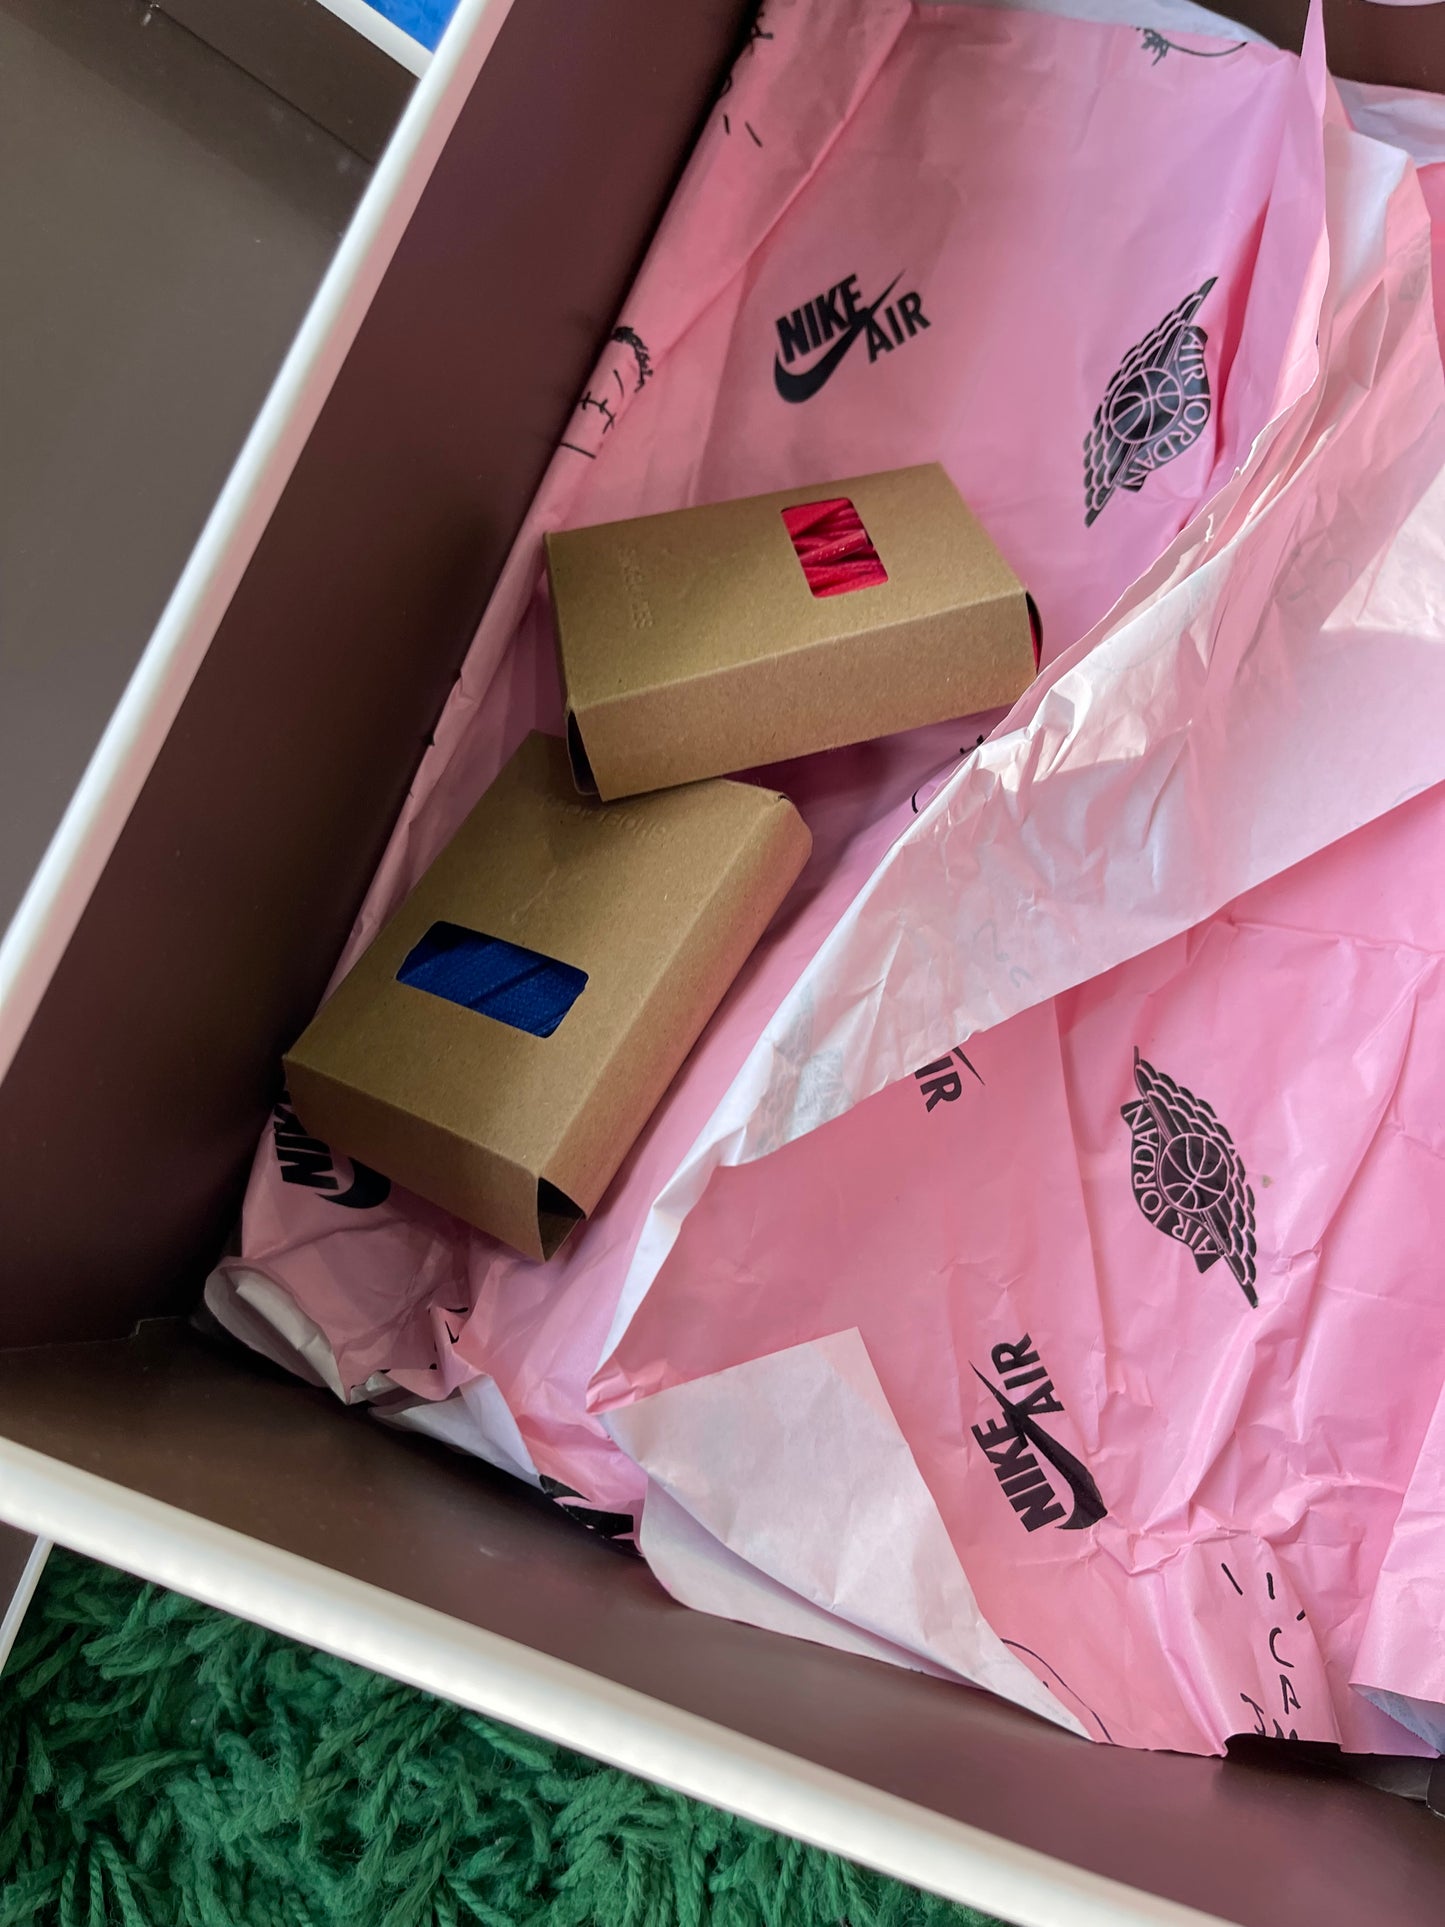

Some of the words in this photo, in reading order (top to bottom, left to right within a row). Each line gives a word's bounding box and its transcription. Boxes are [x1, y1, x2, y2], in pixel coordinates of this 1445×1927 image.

[775, 273, 868, 365] NIKE
[866, 291, 932, 364] AIR
[1181, 331, 1207, 387] AIR
[1124, 392, 1211, 487] JORDAN
[914, 1056, 962, 1113] IR
[1123, 1102, 1171, 1227] JORDAN
[1171, 1210, 1217, 1256] AIR
[991, 1332, 1065, 1415] AIR
[971, 1411, 1067, 1532] NIKE
